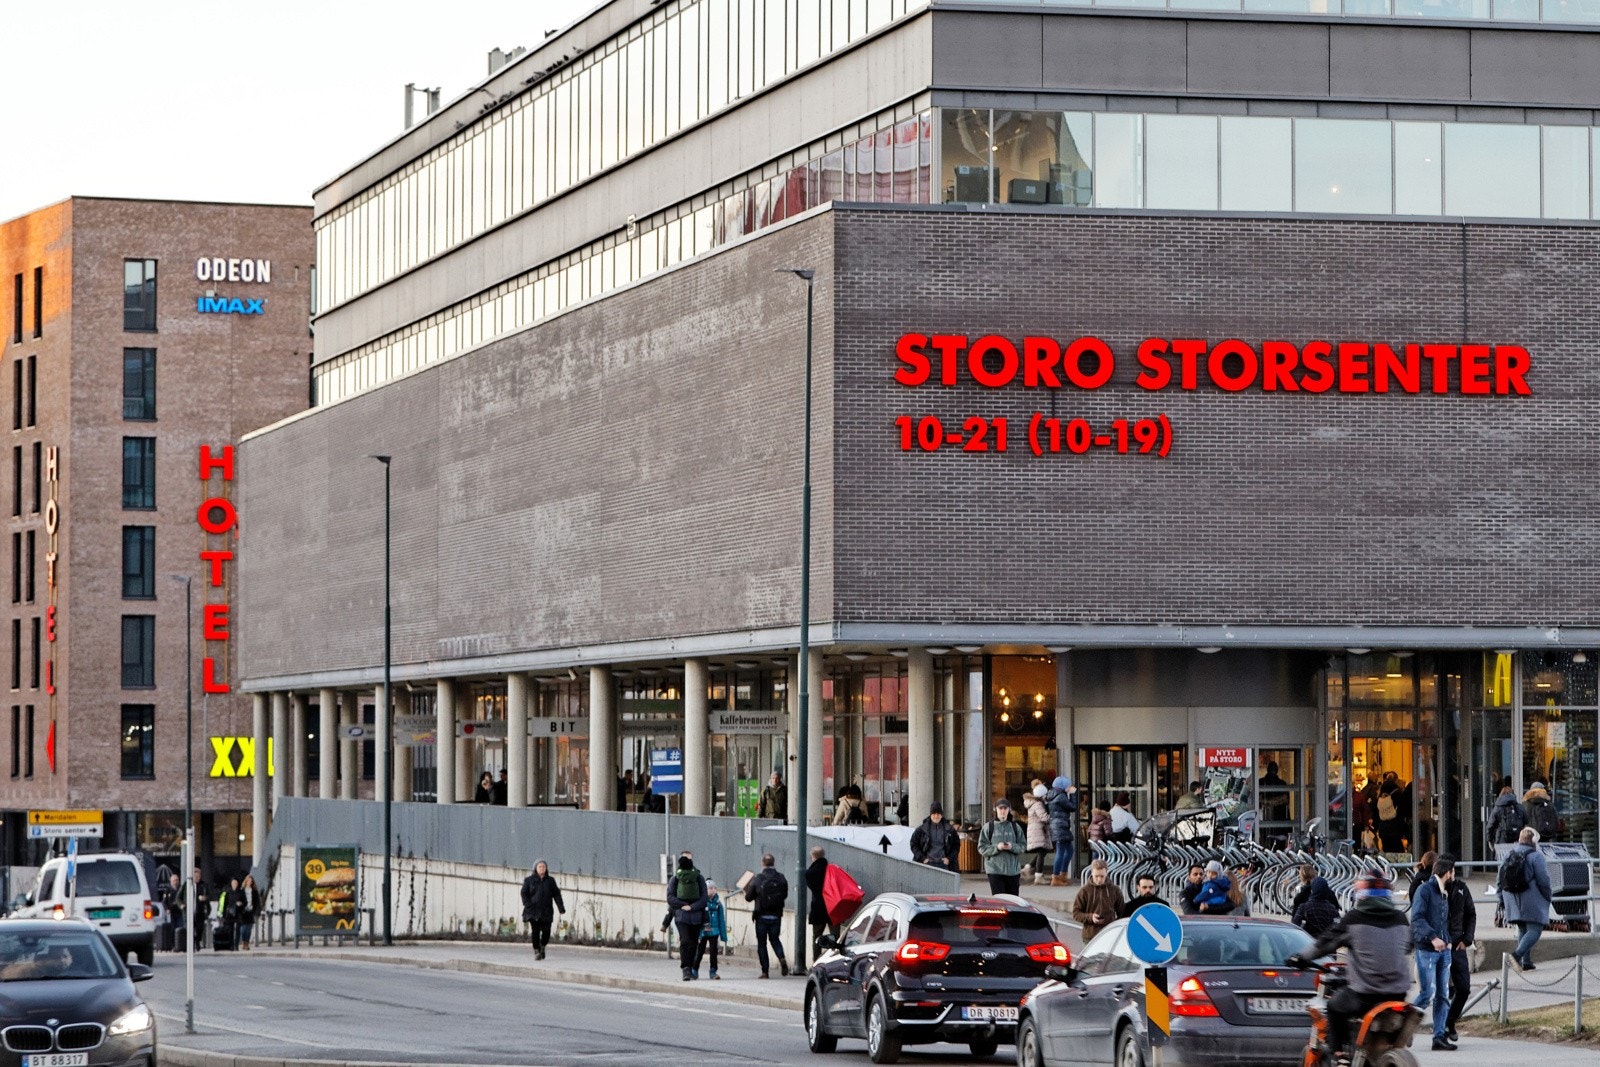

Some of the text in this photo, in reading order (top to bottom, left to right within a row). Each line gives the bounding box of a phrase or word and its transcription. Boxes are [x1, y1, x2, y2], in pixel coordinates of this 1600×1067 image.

[197, 257, 271, 283] ODEON
[197, 297, 264, 315] IMAX
[894, 333, 1532, 396] STORO STORSENTER
[895, 412, 1173, 457] 10-21 (10-19)
[198, 446, 236, 693] HOTEL
[720, 714, 778, 725] Kaffebrenneriet
[550, 722, 576, 733] BIT
[1216, 749, 1236, 757] NYTT
[1209, 755, 1221, 763] PÅ
[307, 864, 323, 875] 39
[969, 1007, 1016, 1018] DR 30819
[32, 1055, 84, 1066] BT 88317
